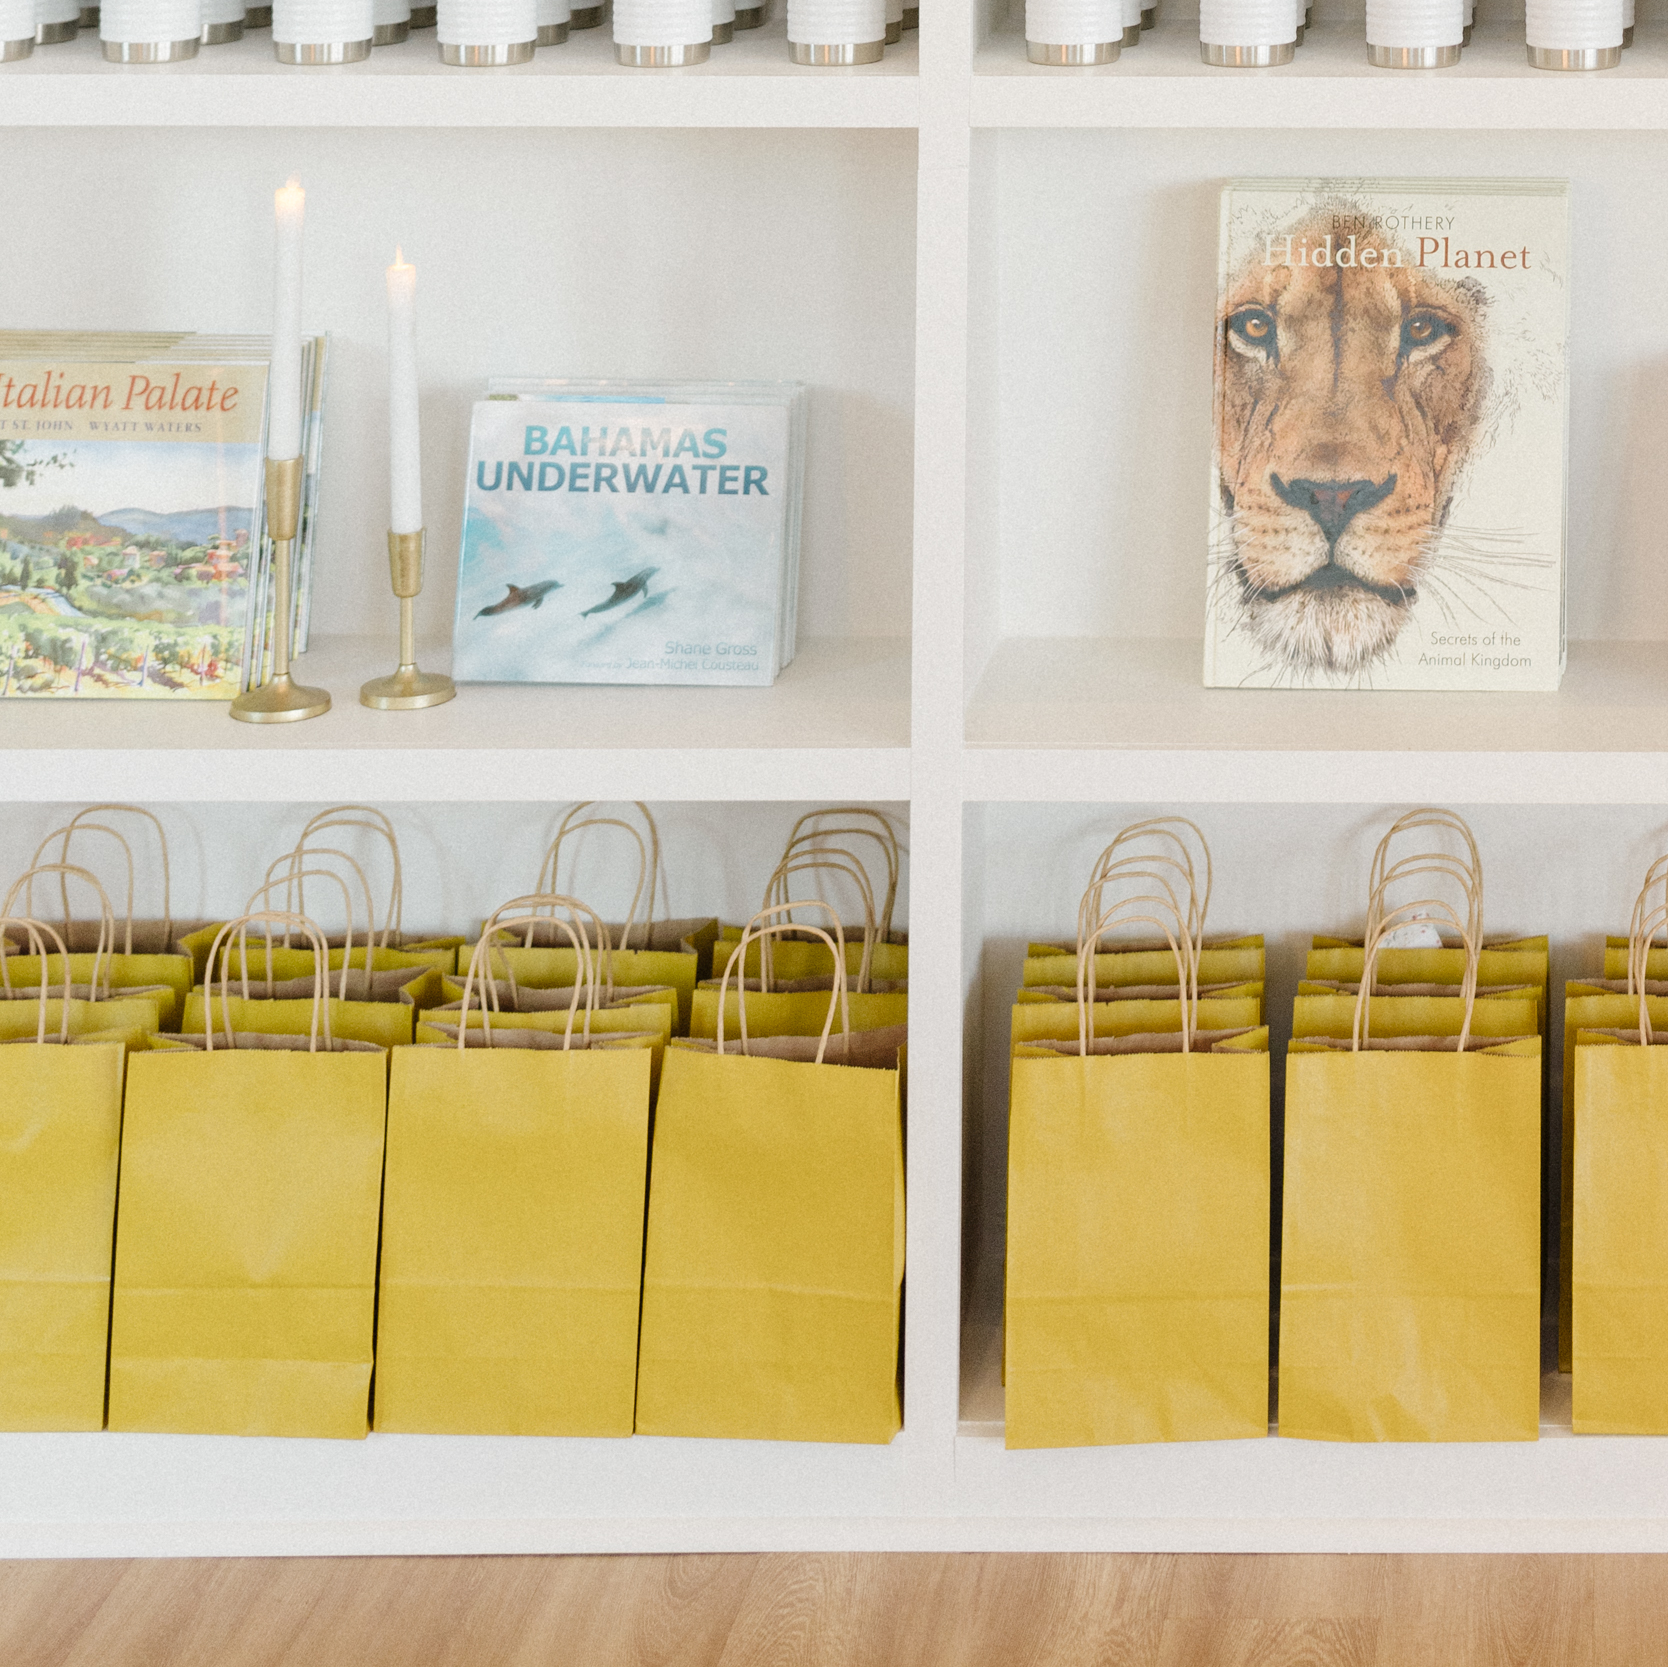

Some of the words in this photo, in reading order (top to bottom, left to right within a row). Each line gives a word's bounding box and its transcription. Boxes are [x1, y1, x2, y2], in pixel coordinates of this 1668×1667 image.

[1332, 215, 1366, 230] BEN
[1375, 216, 1456, 230] ROTHERY
[1262, 234, 1404, 268] Hidden
[1415, 237, 1531, 269] Planet
[121, 372, 238, 412] Palate
[36, 420, 73, 431] JOHN
[89, 421, 138, 431] WYATT
[145, 421, 202, 432] WATERS
[524, 425, 728, 459] BAHAMAS
[477, 461, 769, 495] UNDERWATER
[1431, 632, 1478, 647] Secrets
[1482, 631, 1496, 647] of
[1500, 632, 1521, 647] the
[664, 641, 712, 655] Shane
[716, 642, 757, 655] Gross
[1419, 652, 1466, 667] Animal
[1470, 652, 1532, 669] Kingdom
